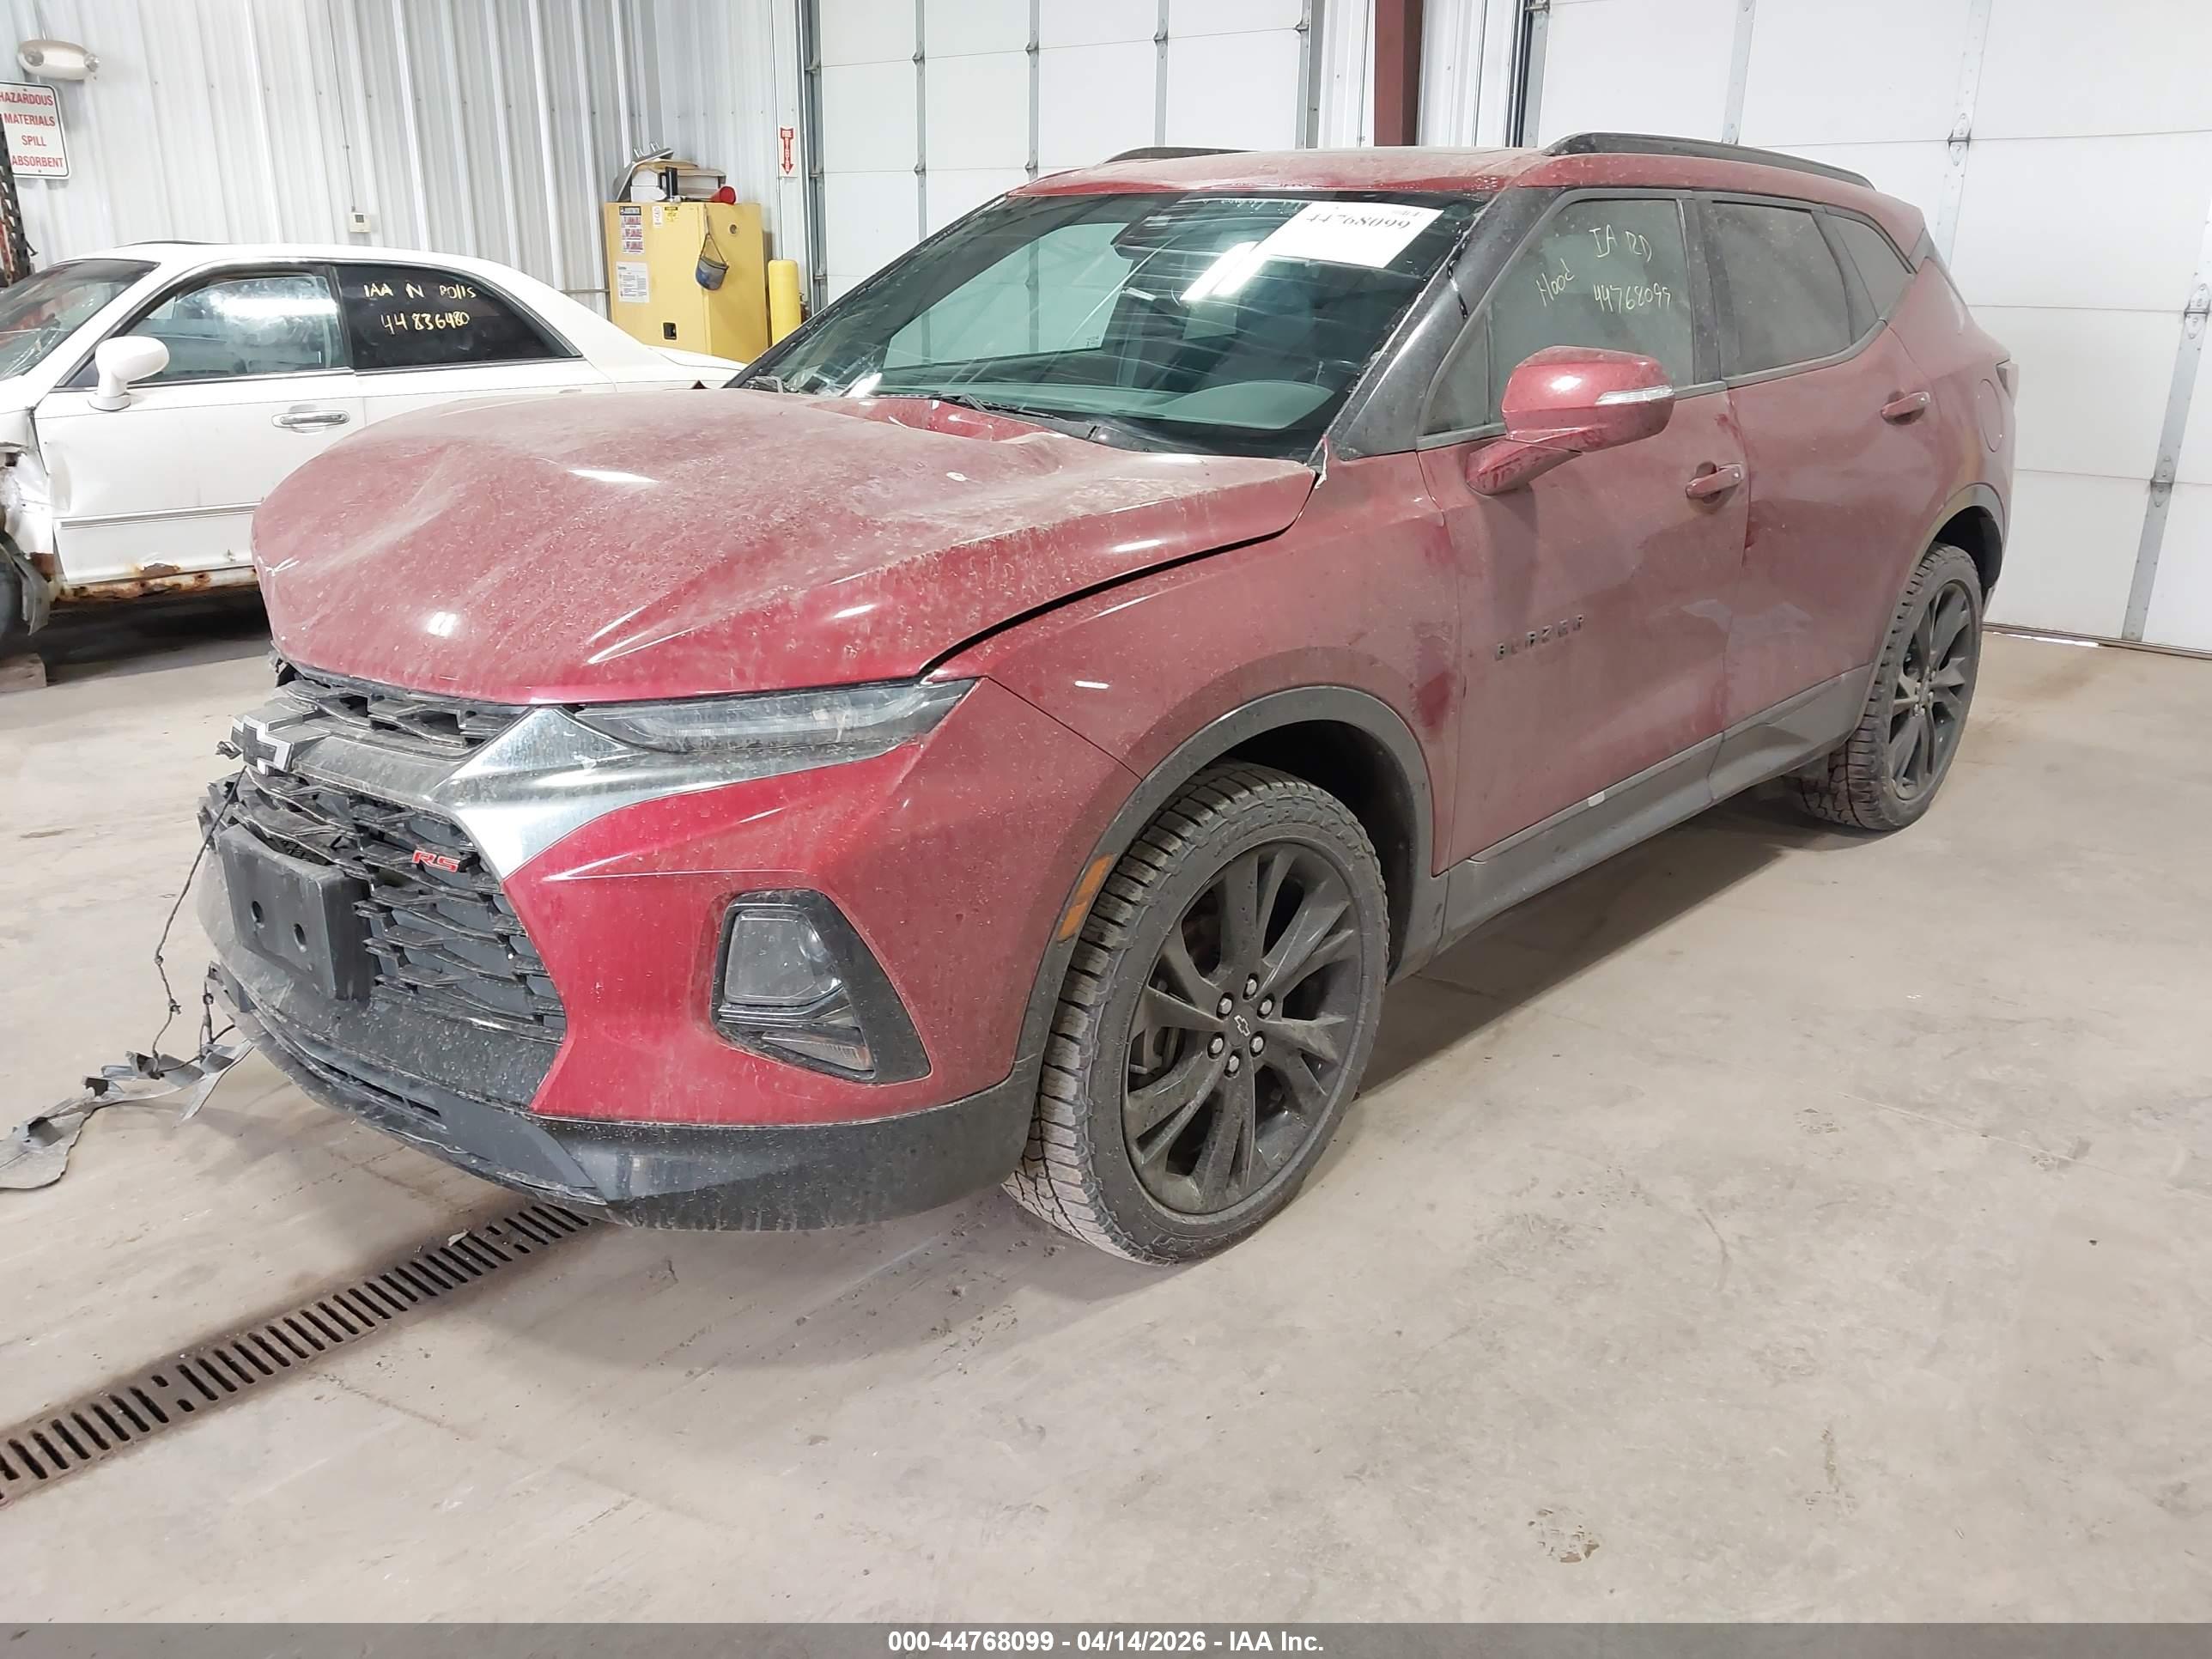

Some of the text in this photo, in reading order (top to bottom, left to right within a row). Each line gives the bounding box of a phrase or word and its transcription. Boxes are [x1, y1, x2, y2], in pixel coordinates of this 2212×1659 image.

[0, 92, 54, 106] HAZARDOUS
[3, 112, 56, 127] MATERIALS
[21, 135, 47, 147] SPILL
[11, 155, 64, 167] ABSORBENT
[1535, 258, 1575, 307] Hood
[363, 283, 394, 298] IAA
[405, 283, 425, 299] N
[1593, 283, 1671, 314] 44768099
[412, 849, 460, 872] RS
